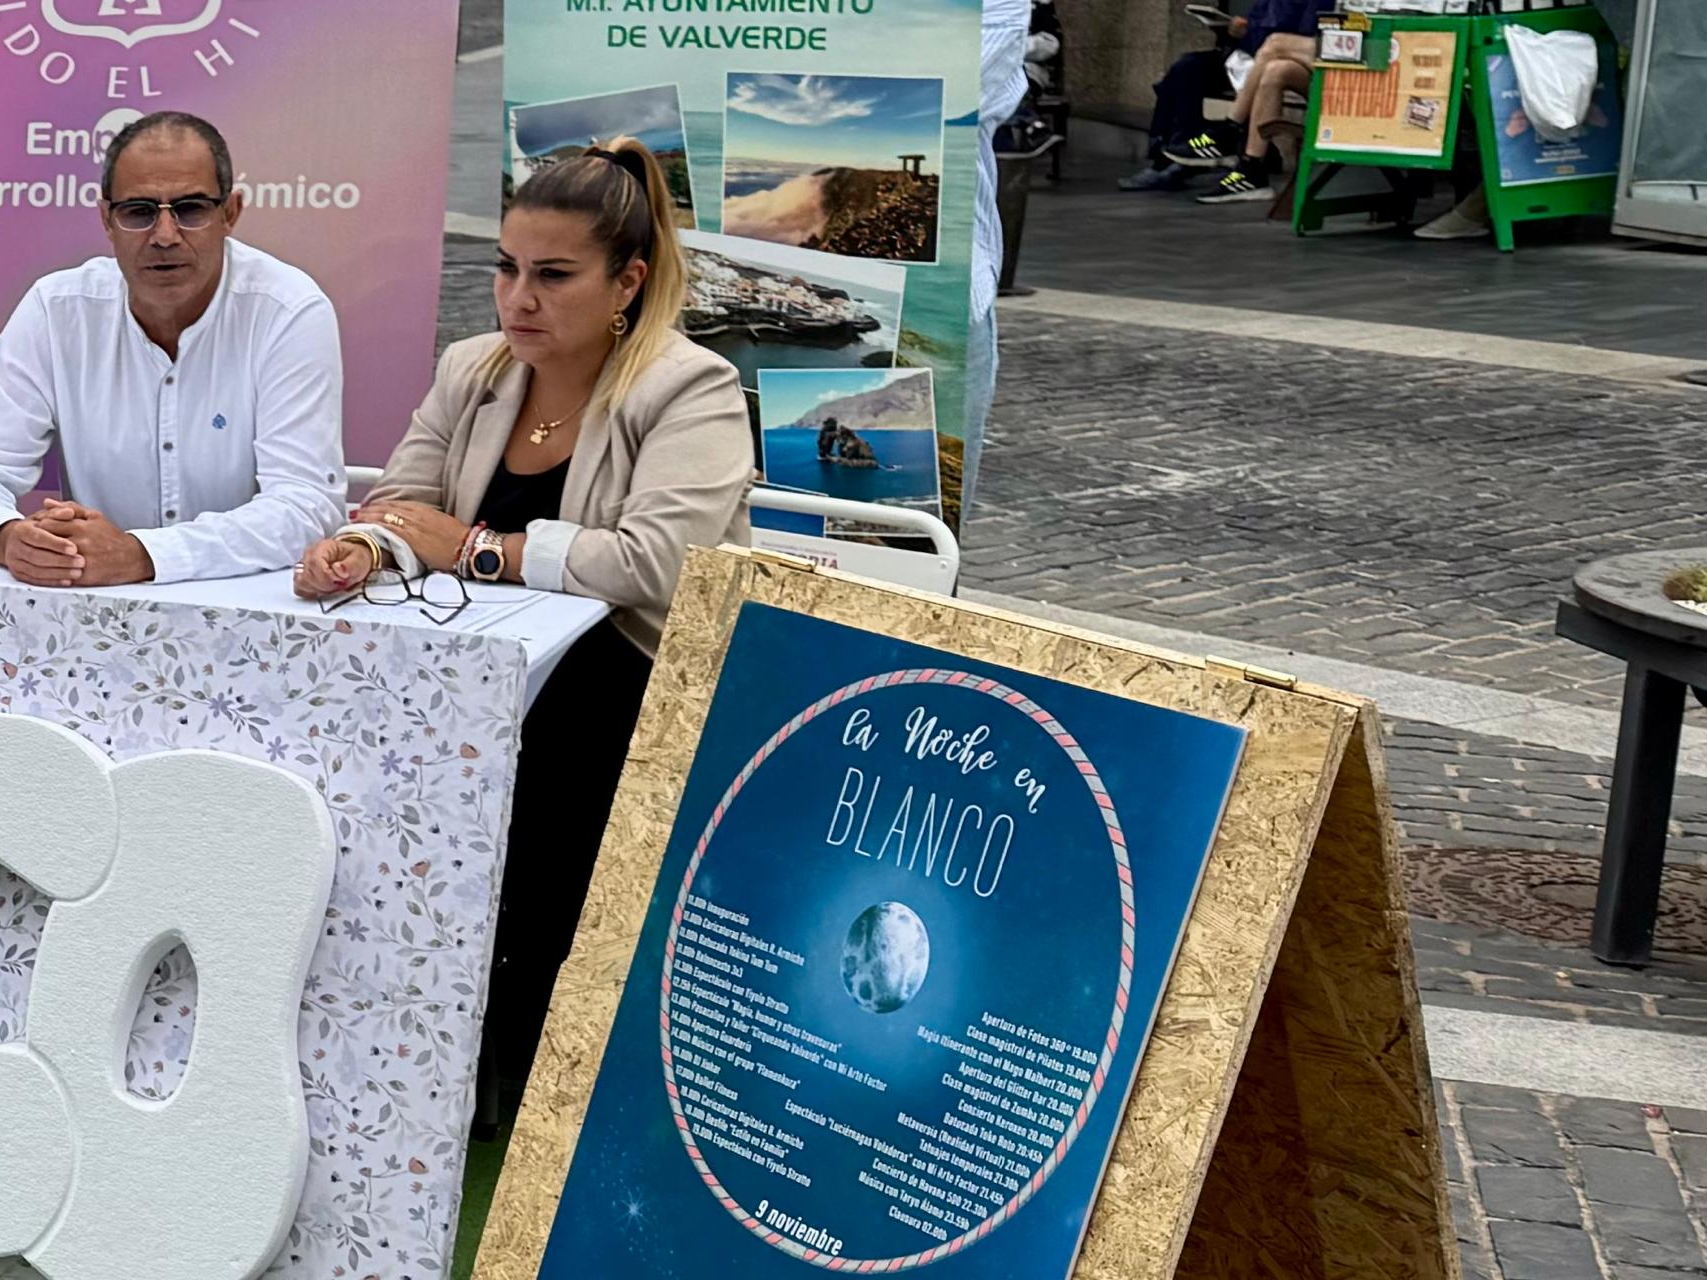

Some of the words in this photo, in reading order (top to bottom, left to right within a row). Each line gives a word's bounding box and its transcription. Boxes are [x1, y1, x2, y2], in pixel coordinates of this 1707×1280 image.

[607, 24, 647, 49] DE
[658, 25, 827, 51] VALVERDE
[107, 66, 162, 98] EL
[905, 706, 997, 775] Noche
[1014, 768, 1046, 815] en
[826, 767, 1015, 898] BLANCO
[755, 1199, 769, 1219] 9
[766, 1208, 844, 1256] noviembre
